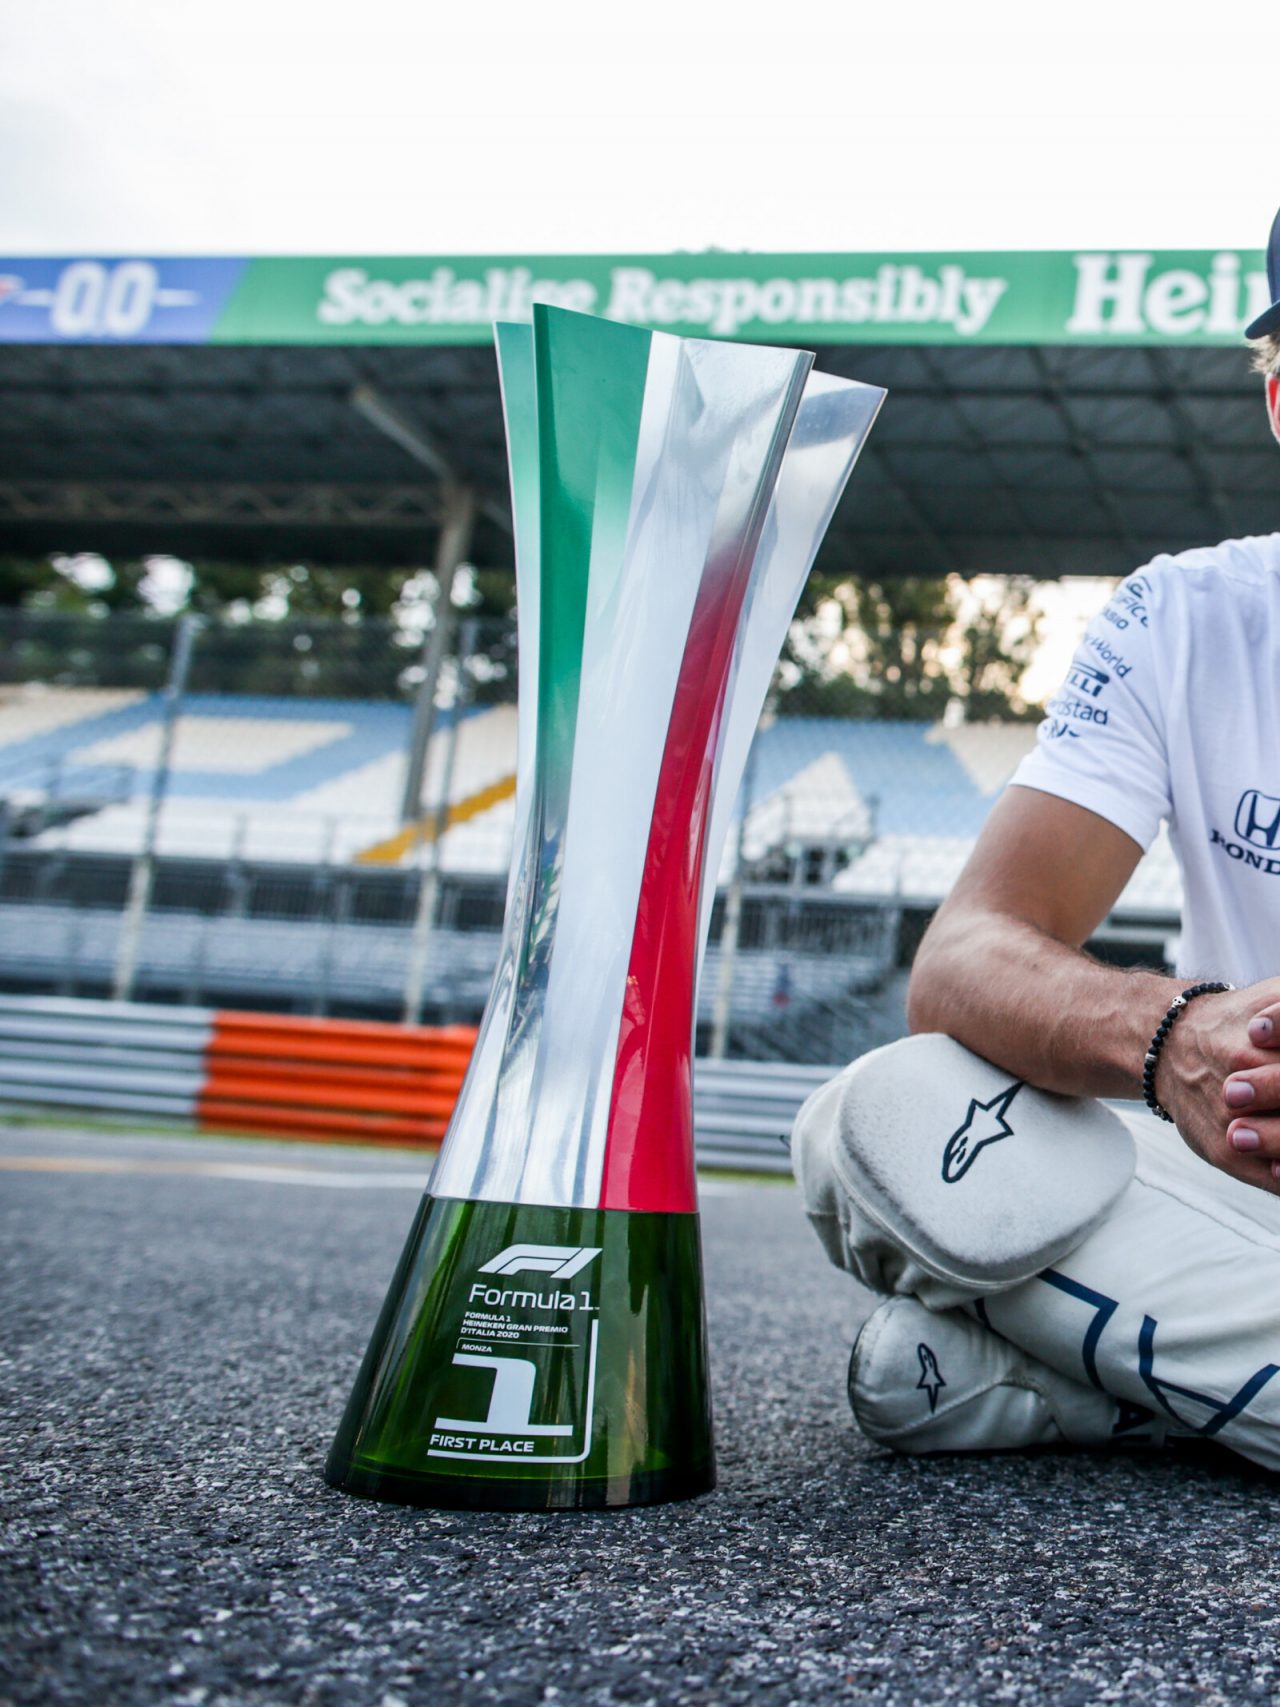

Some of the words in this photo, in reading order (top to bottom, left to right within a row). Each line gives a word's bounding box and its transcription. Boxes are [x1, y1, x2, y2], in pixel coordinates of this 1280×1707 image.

[603, 263, 1008, 336] Responsibly
[464, 1311, 507, 1322] FORMULA
[460, 1327, 496, 1337] D'ITALIA
[496, 1331, 520, 1339] 2020
[462, 1320, 506, 1330] HEINEKEN
[506, 1323, 533, 1332] GRAN
[533, 1325, 569, 1334] PREMIO
[461, 1343, 493, 1353] MONZA
[434, 1353, 574, 1436] 1
[429, 1434, 477, 1450] FIRST
[478, 1439, 535, 1453] PLACE
